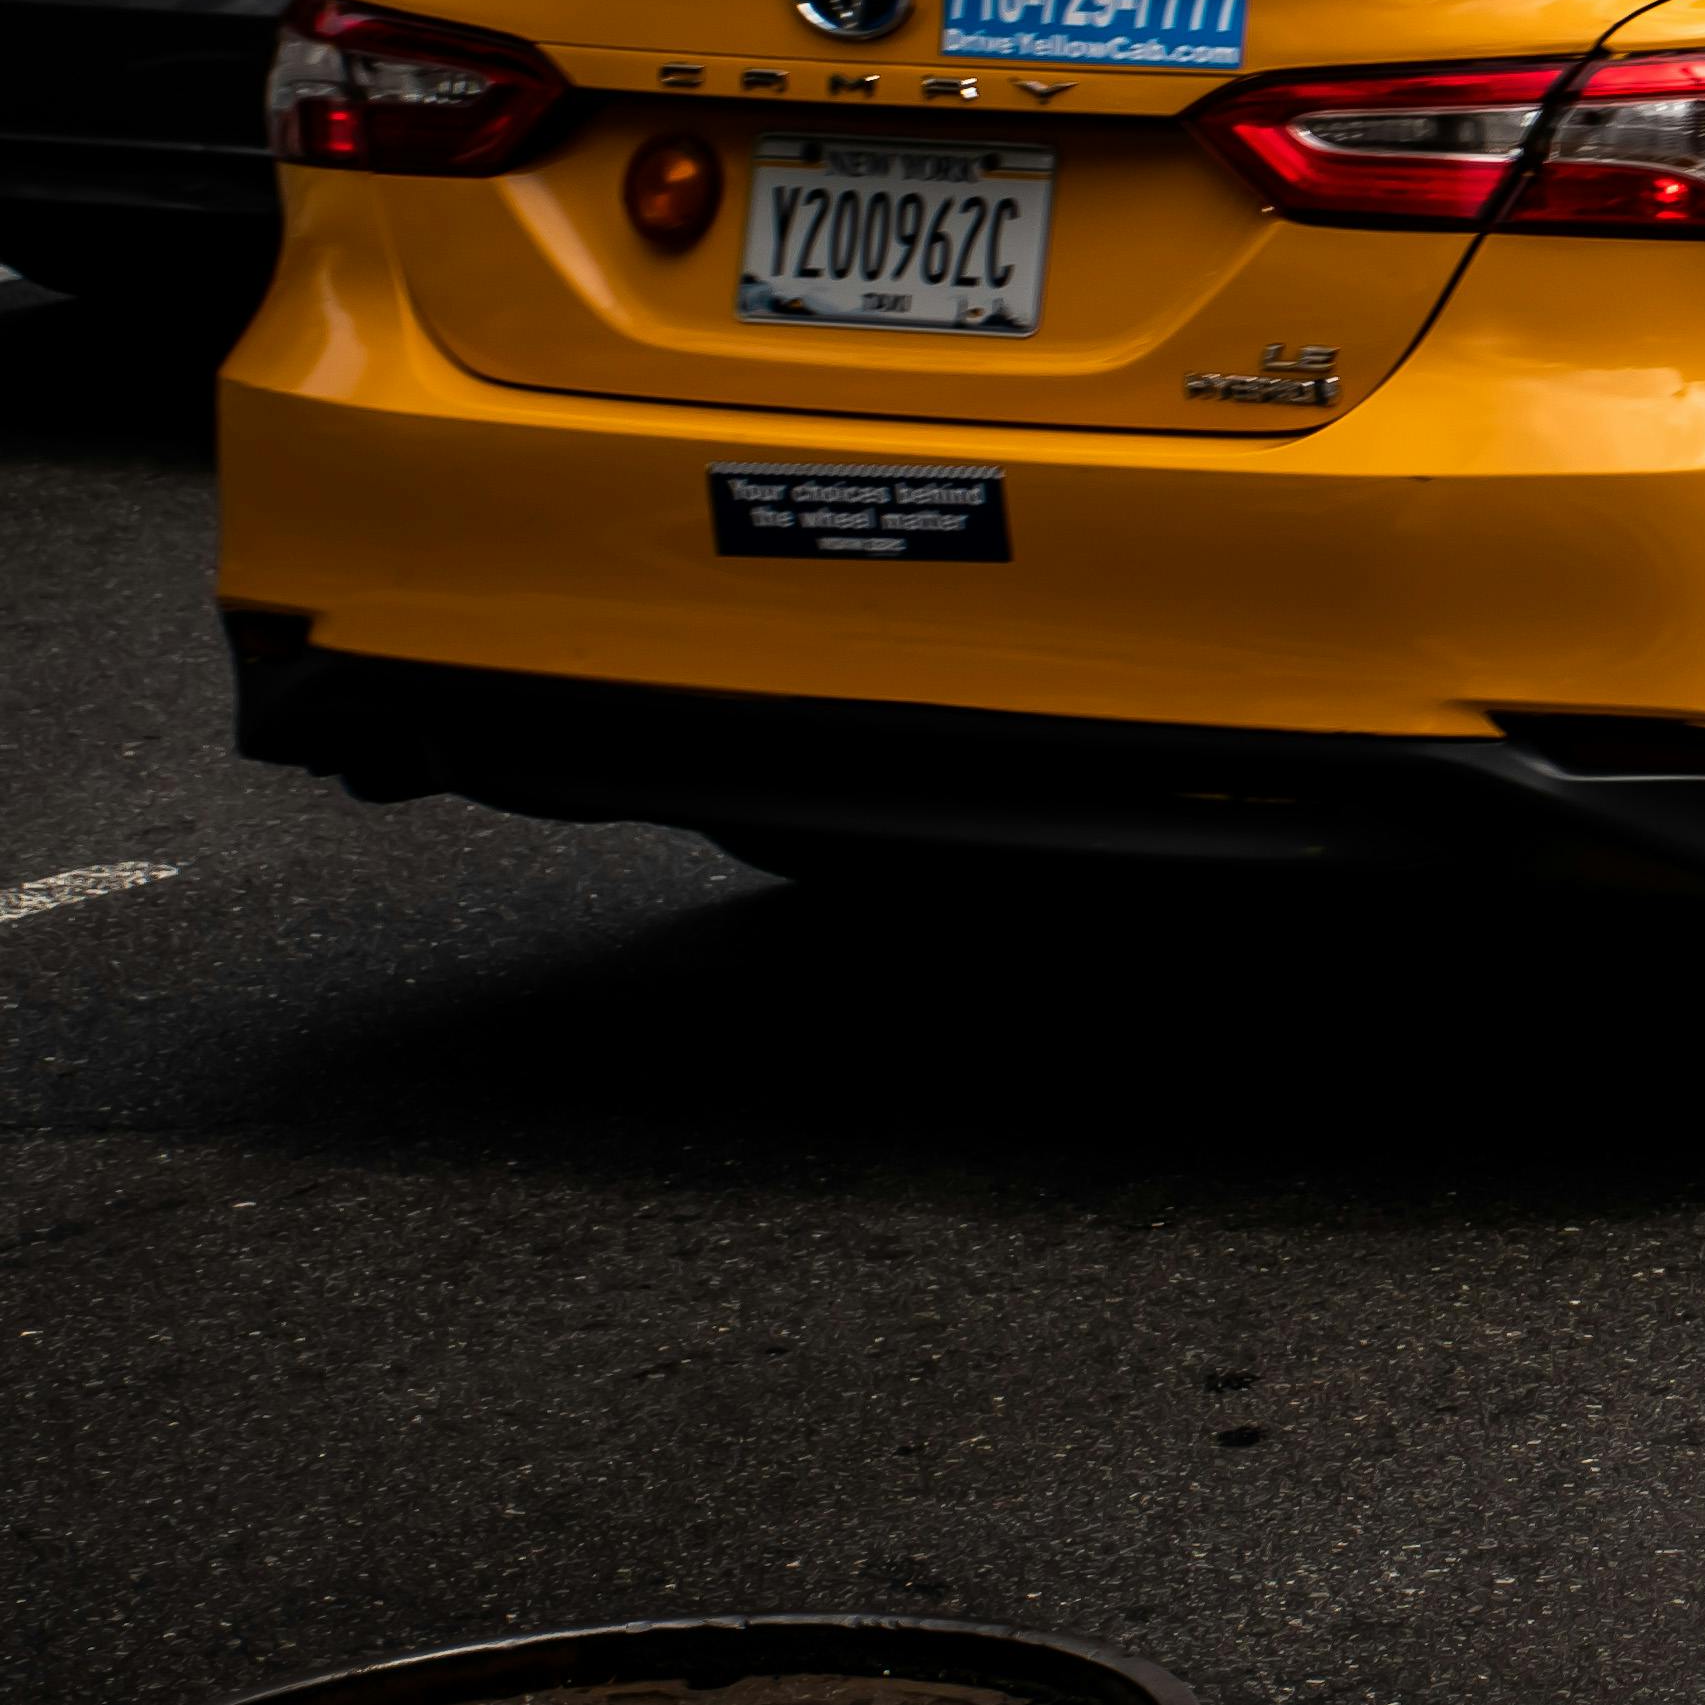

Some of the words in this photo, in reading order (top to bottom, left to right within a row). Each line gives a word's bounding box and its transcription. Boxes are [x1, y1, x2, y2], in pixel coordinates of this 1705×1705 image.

[942, 27, 1241, 64] DriveYellowCab.com
[658, 61, 1080, 104] CAMRY
[826, 150, 893, 177] NEW
[899, 152, 980, 183] YORK
[770, 185, 1021, 289] Y200962C
[1261, 343, 1341, 372] LE
[727, 478, 788, 501] Your
[790, 480, 892, 504] choices
[894, 482, 986, 506] behind
[750, 505, 796, 528] the
[800, 507, 878, 529] wheel
[880, 509, 969, 532] matter
